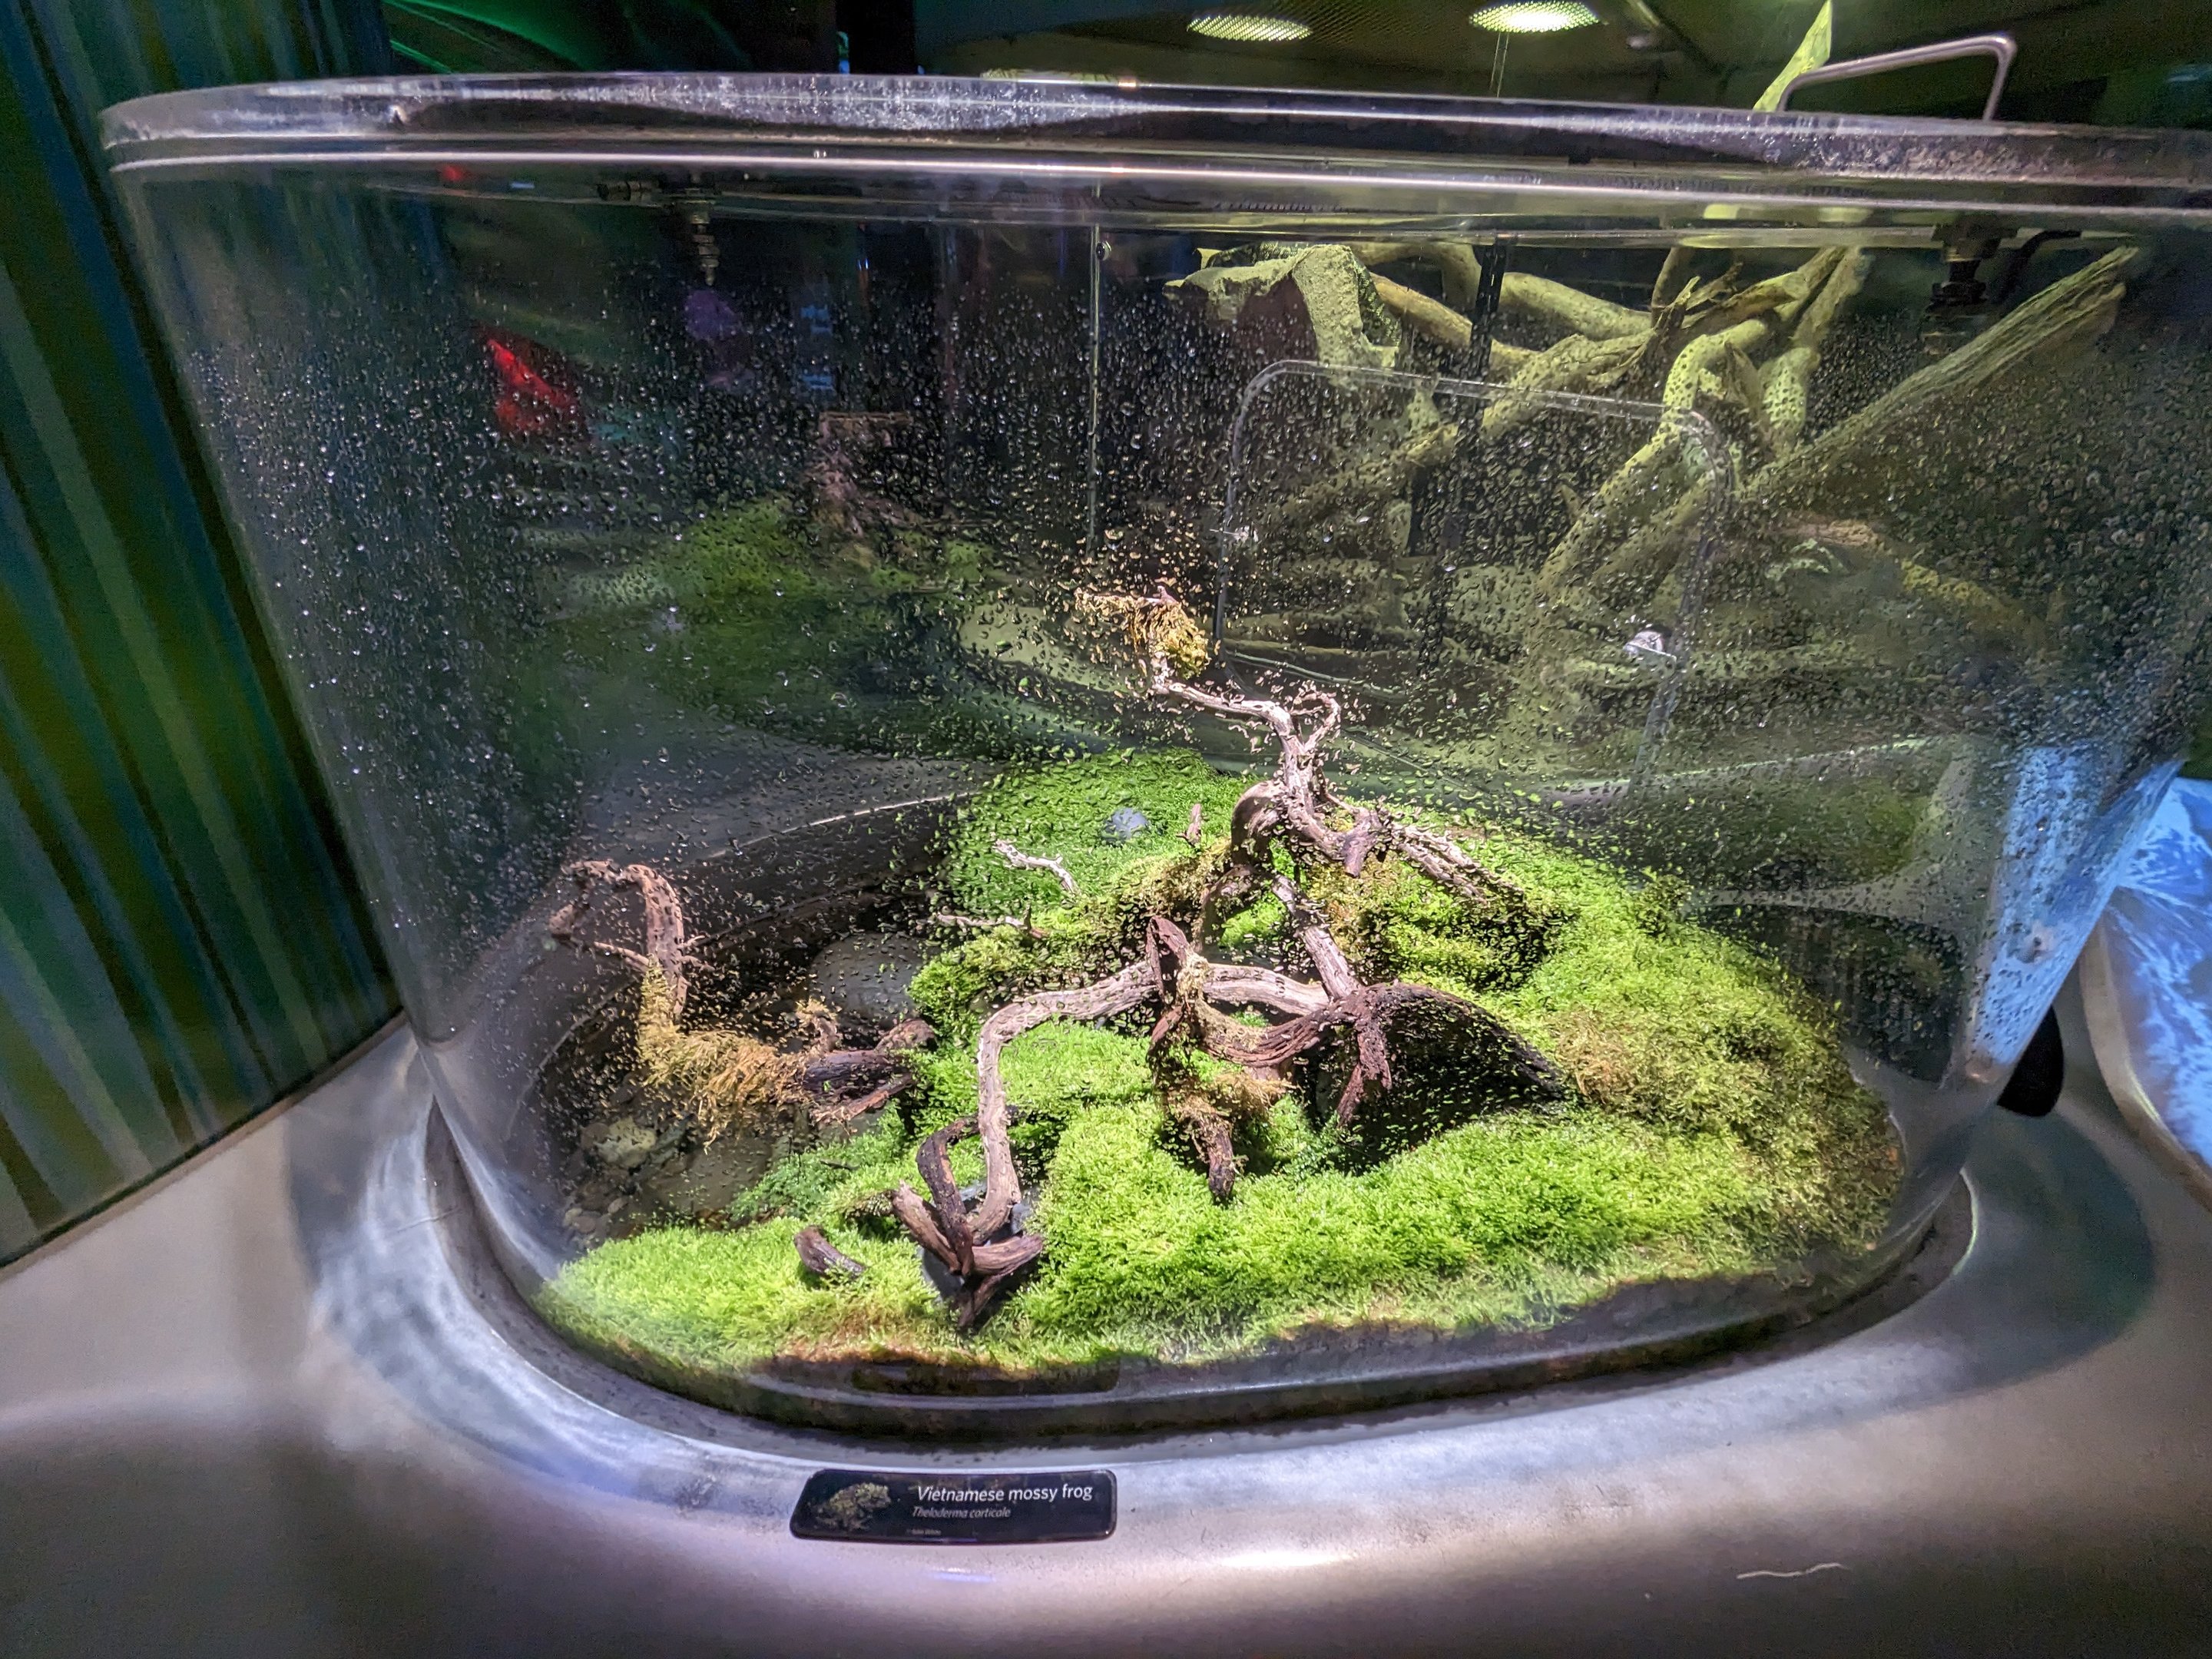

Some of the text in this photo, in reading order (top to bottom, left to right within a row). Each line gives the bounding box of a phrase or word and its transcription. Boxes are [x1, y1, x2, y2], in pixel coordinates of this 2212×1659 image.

[917, 1483, 1093, 1503] Vietnamese mossy frog
[912, 1506, 1011, 1518] Theloderma corticale
